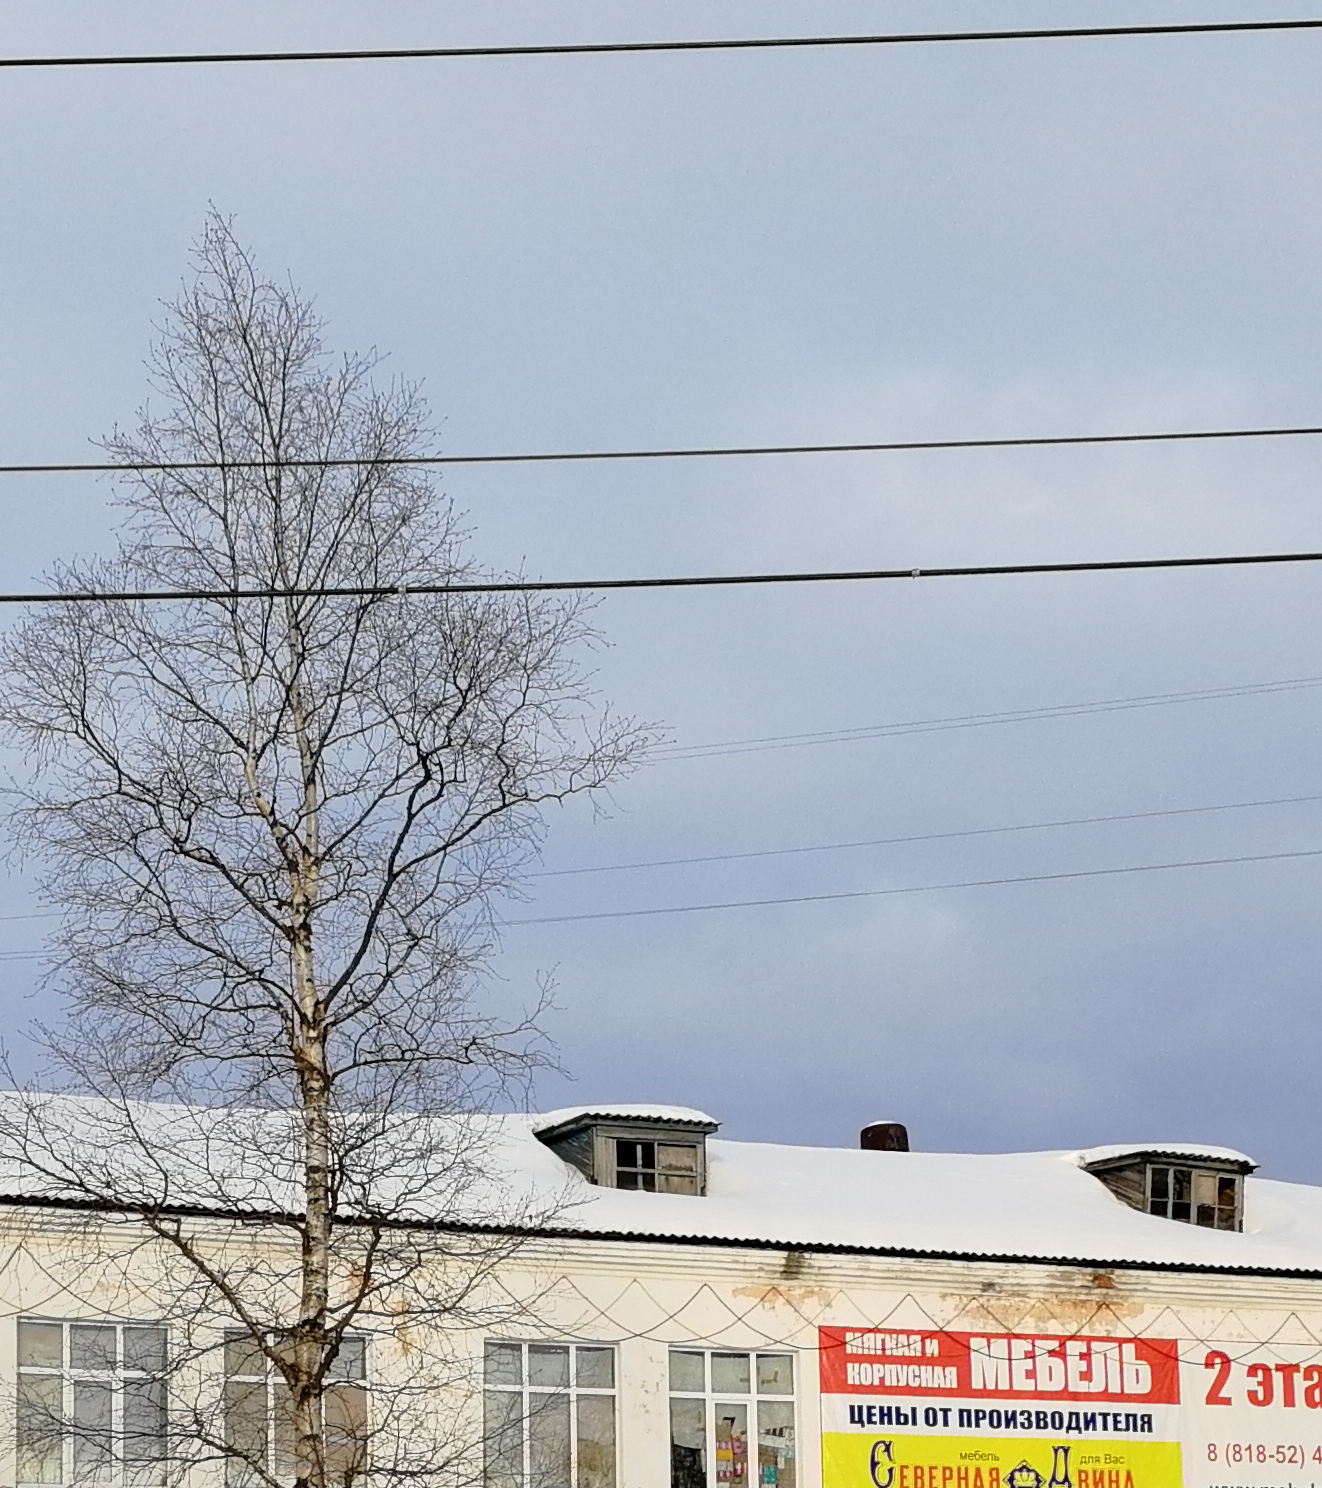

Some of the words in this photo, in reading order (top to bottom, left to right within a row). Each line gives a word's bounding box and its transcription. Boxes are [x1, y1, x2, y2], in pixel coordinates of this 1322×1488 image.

[845, 1332, 922, 1357] МЯГКАЯ
[847, 1362, 958, 1388] КОРПУСНАЯ
[969, 1337, 1153, 1394] МЕБЕЛЬ
[1204, 1350, 1233, 1406] 2
[849, 1404, 918, 1428] ЦЕНЫ
[924, 1406, 952, 1428] ОТ
[958, 1408, 1154, 1434] ПРОИЗВОДИТЕЛЯ
[959, 1450, 1000, 1462] мебель
[1079, 1454, 1101, 1465] для
[1104, 1453, 1125, 1465] Вас
[1207, 1443, 1218, 1462] 8
[1226, 1442, 1305, 1469] (818-52)
